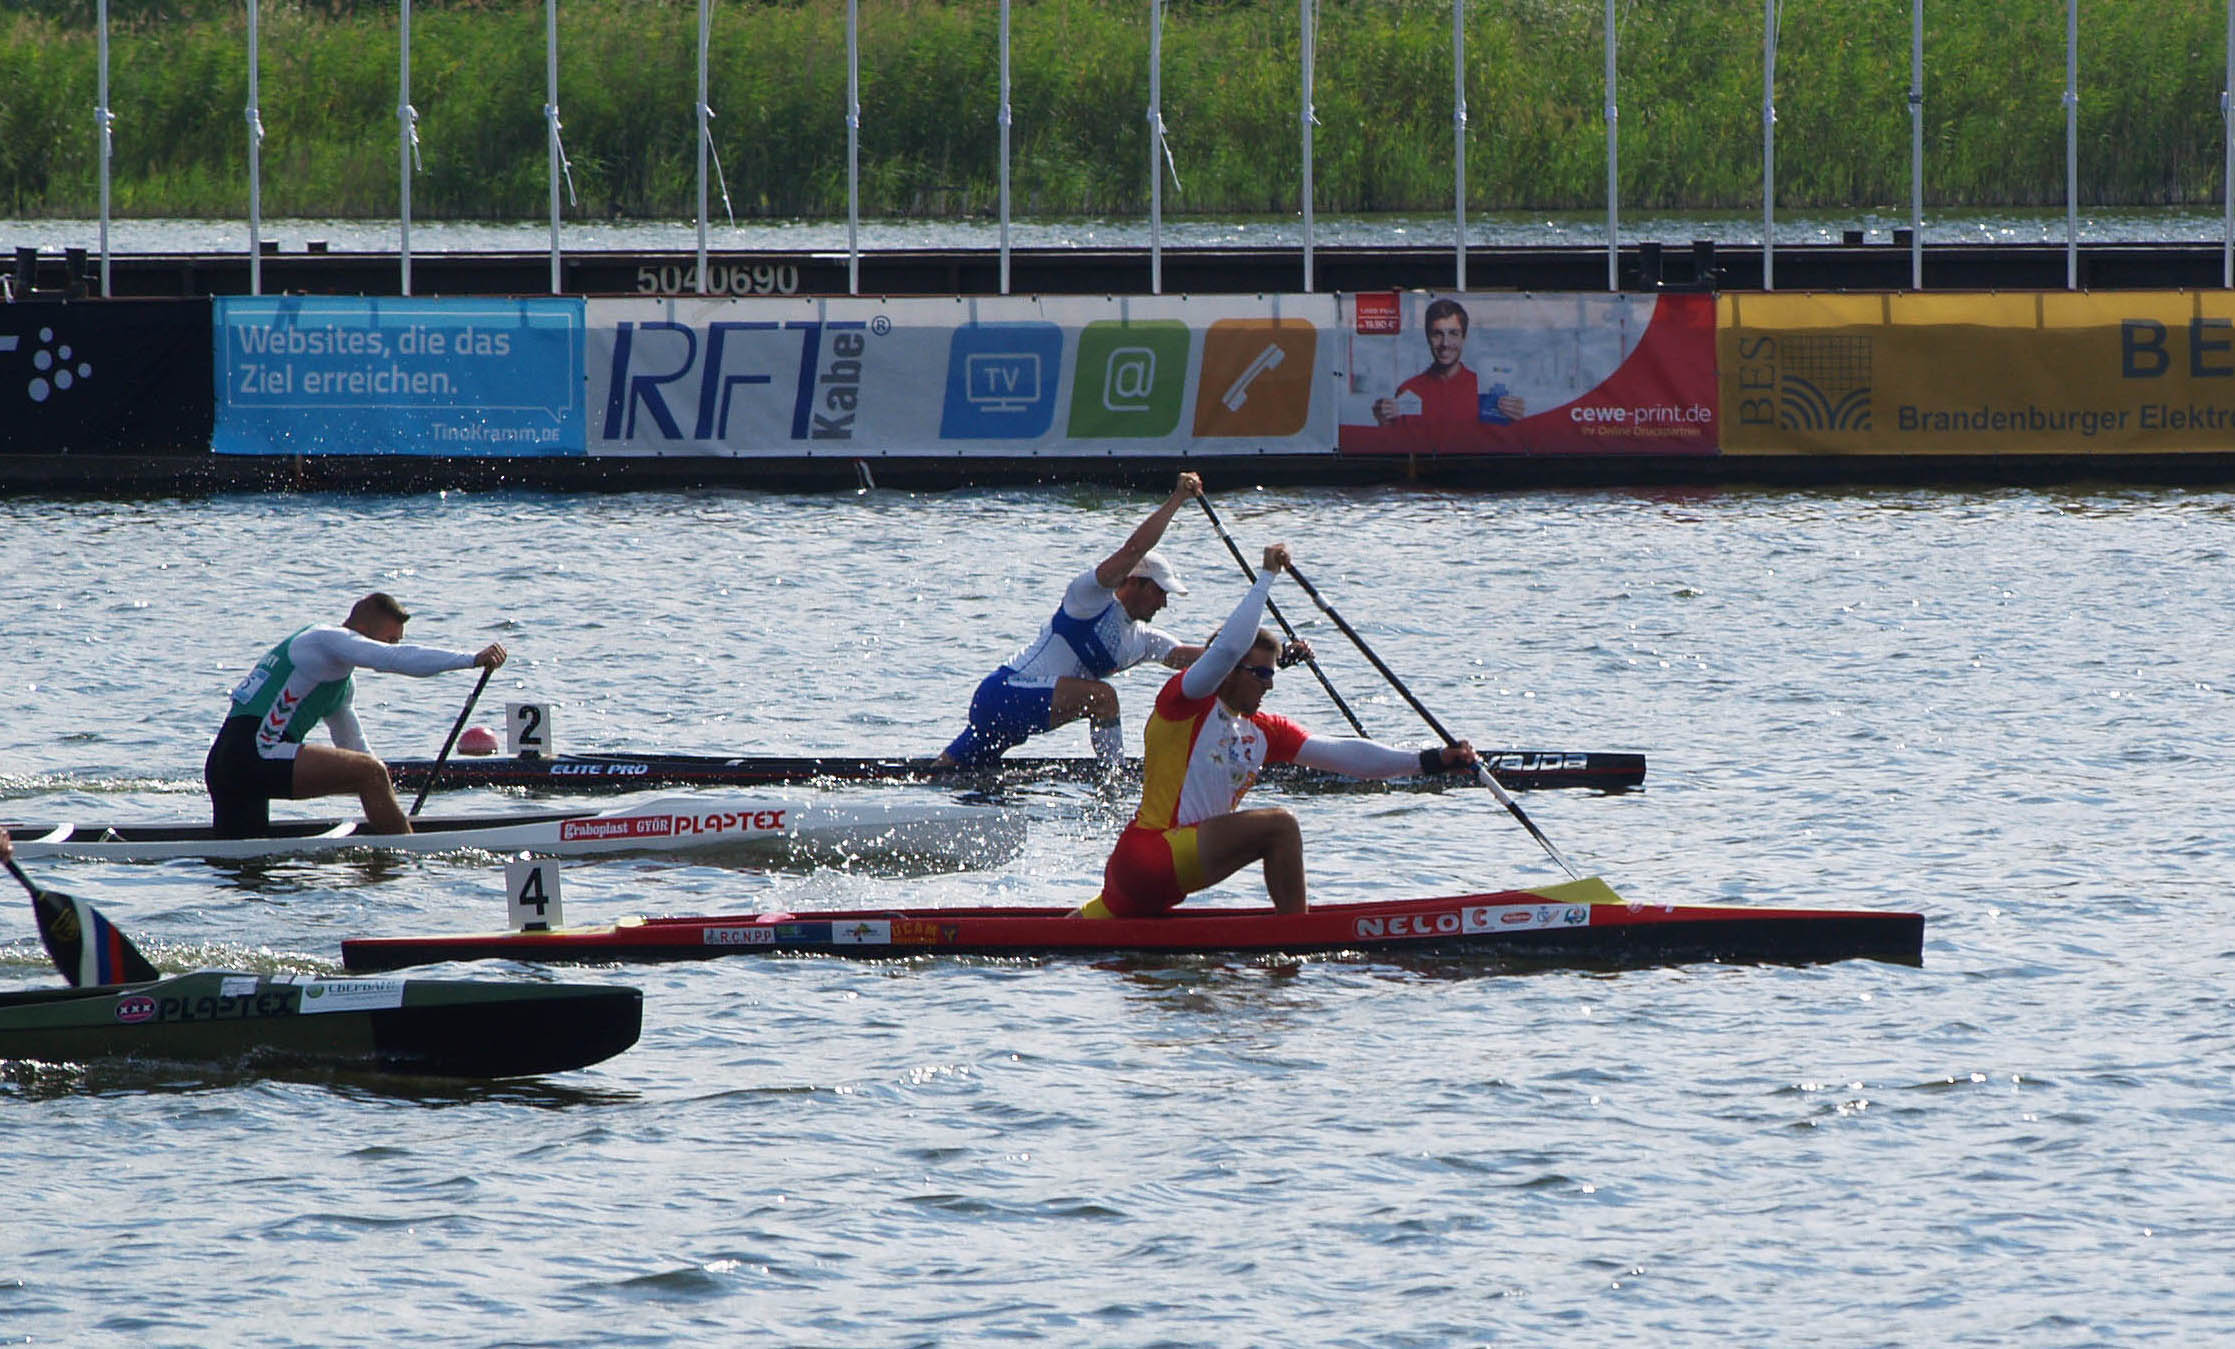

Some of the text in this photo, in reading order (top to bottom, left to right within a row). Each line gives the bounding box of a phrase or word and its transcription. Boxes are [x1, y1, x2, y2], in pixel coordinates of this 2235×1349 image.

[637, 265, 799, 294] 5040690
[239, 324, 511, 359] Websites, die das
[240, 363, 458, 394] Ziel erreichen.
[983, 367, 1020, 392] TV
[1740, 336, 1776, 426] BES
[1570, 403, 1713, 425] cewe-print.de
[1899, 405, 2129, 437] Brandenburger
[518, 705, 542, 745] 2
[550, 763, 648, 775] ELITE PRO
[674, 810, 786, 835] PLASTEX
[519, 866, 549, 916] 4
[1356, 913, 1460, 937] NELO
